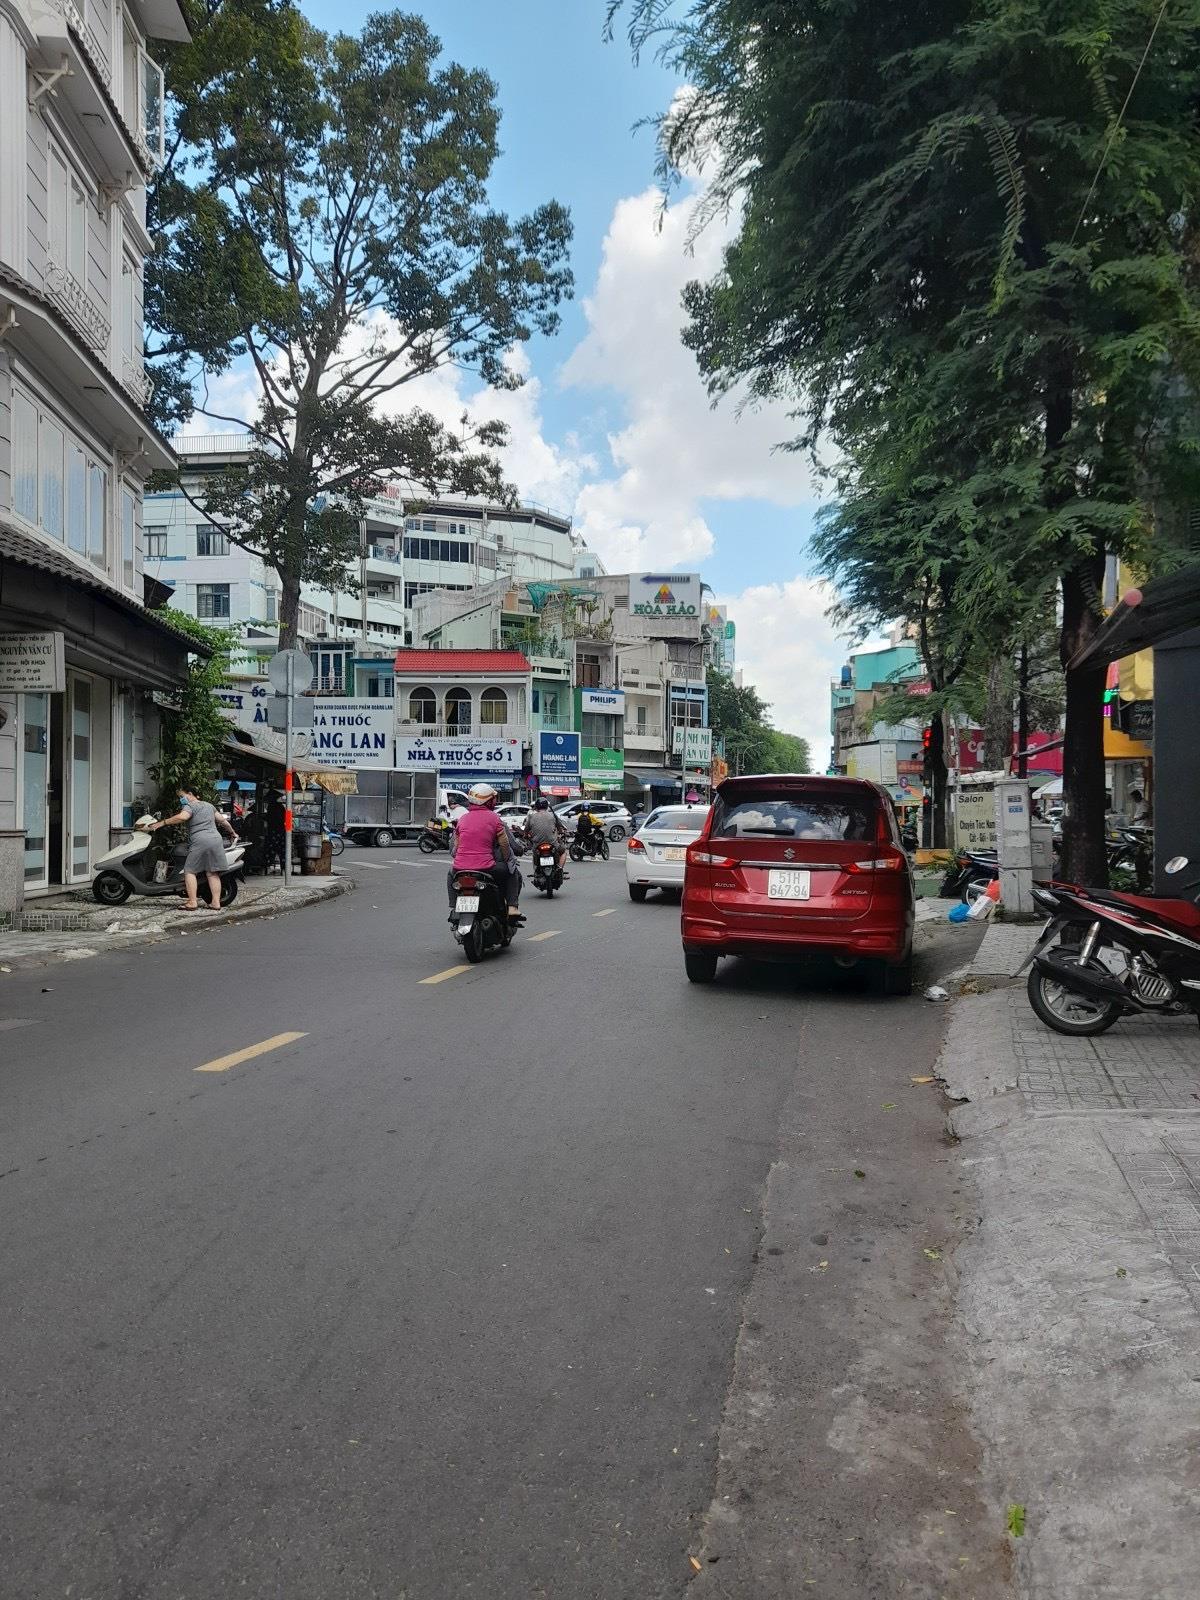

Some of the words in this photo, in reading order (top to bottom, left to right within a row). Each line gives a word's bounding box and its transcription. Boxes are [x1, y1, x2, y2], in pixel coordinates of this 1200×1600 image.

[634, 600, 662, 614] HÒA
[667, 600, 696, 614] HẢO
[590, 696, 617, 704] PHILIPS
[331, 712, 371, 726] THUỐC
[350, 732, 386, 749] LAN
[407, 747, 436, 761] NHÀ
[438, 747, 483, 761] THUỐC
[486, 747, 503, 761] SỐ
[507, 752, 512, 761] 1
[565, 754, 577, 762] LAN
[958, 795, 984, 804] Salon
[778, 873, 801, 884] 51H
[769, 884, 808, 898] 647.94
